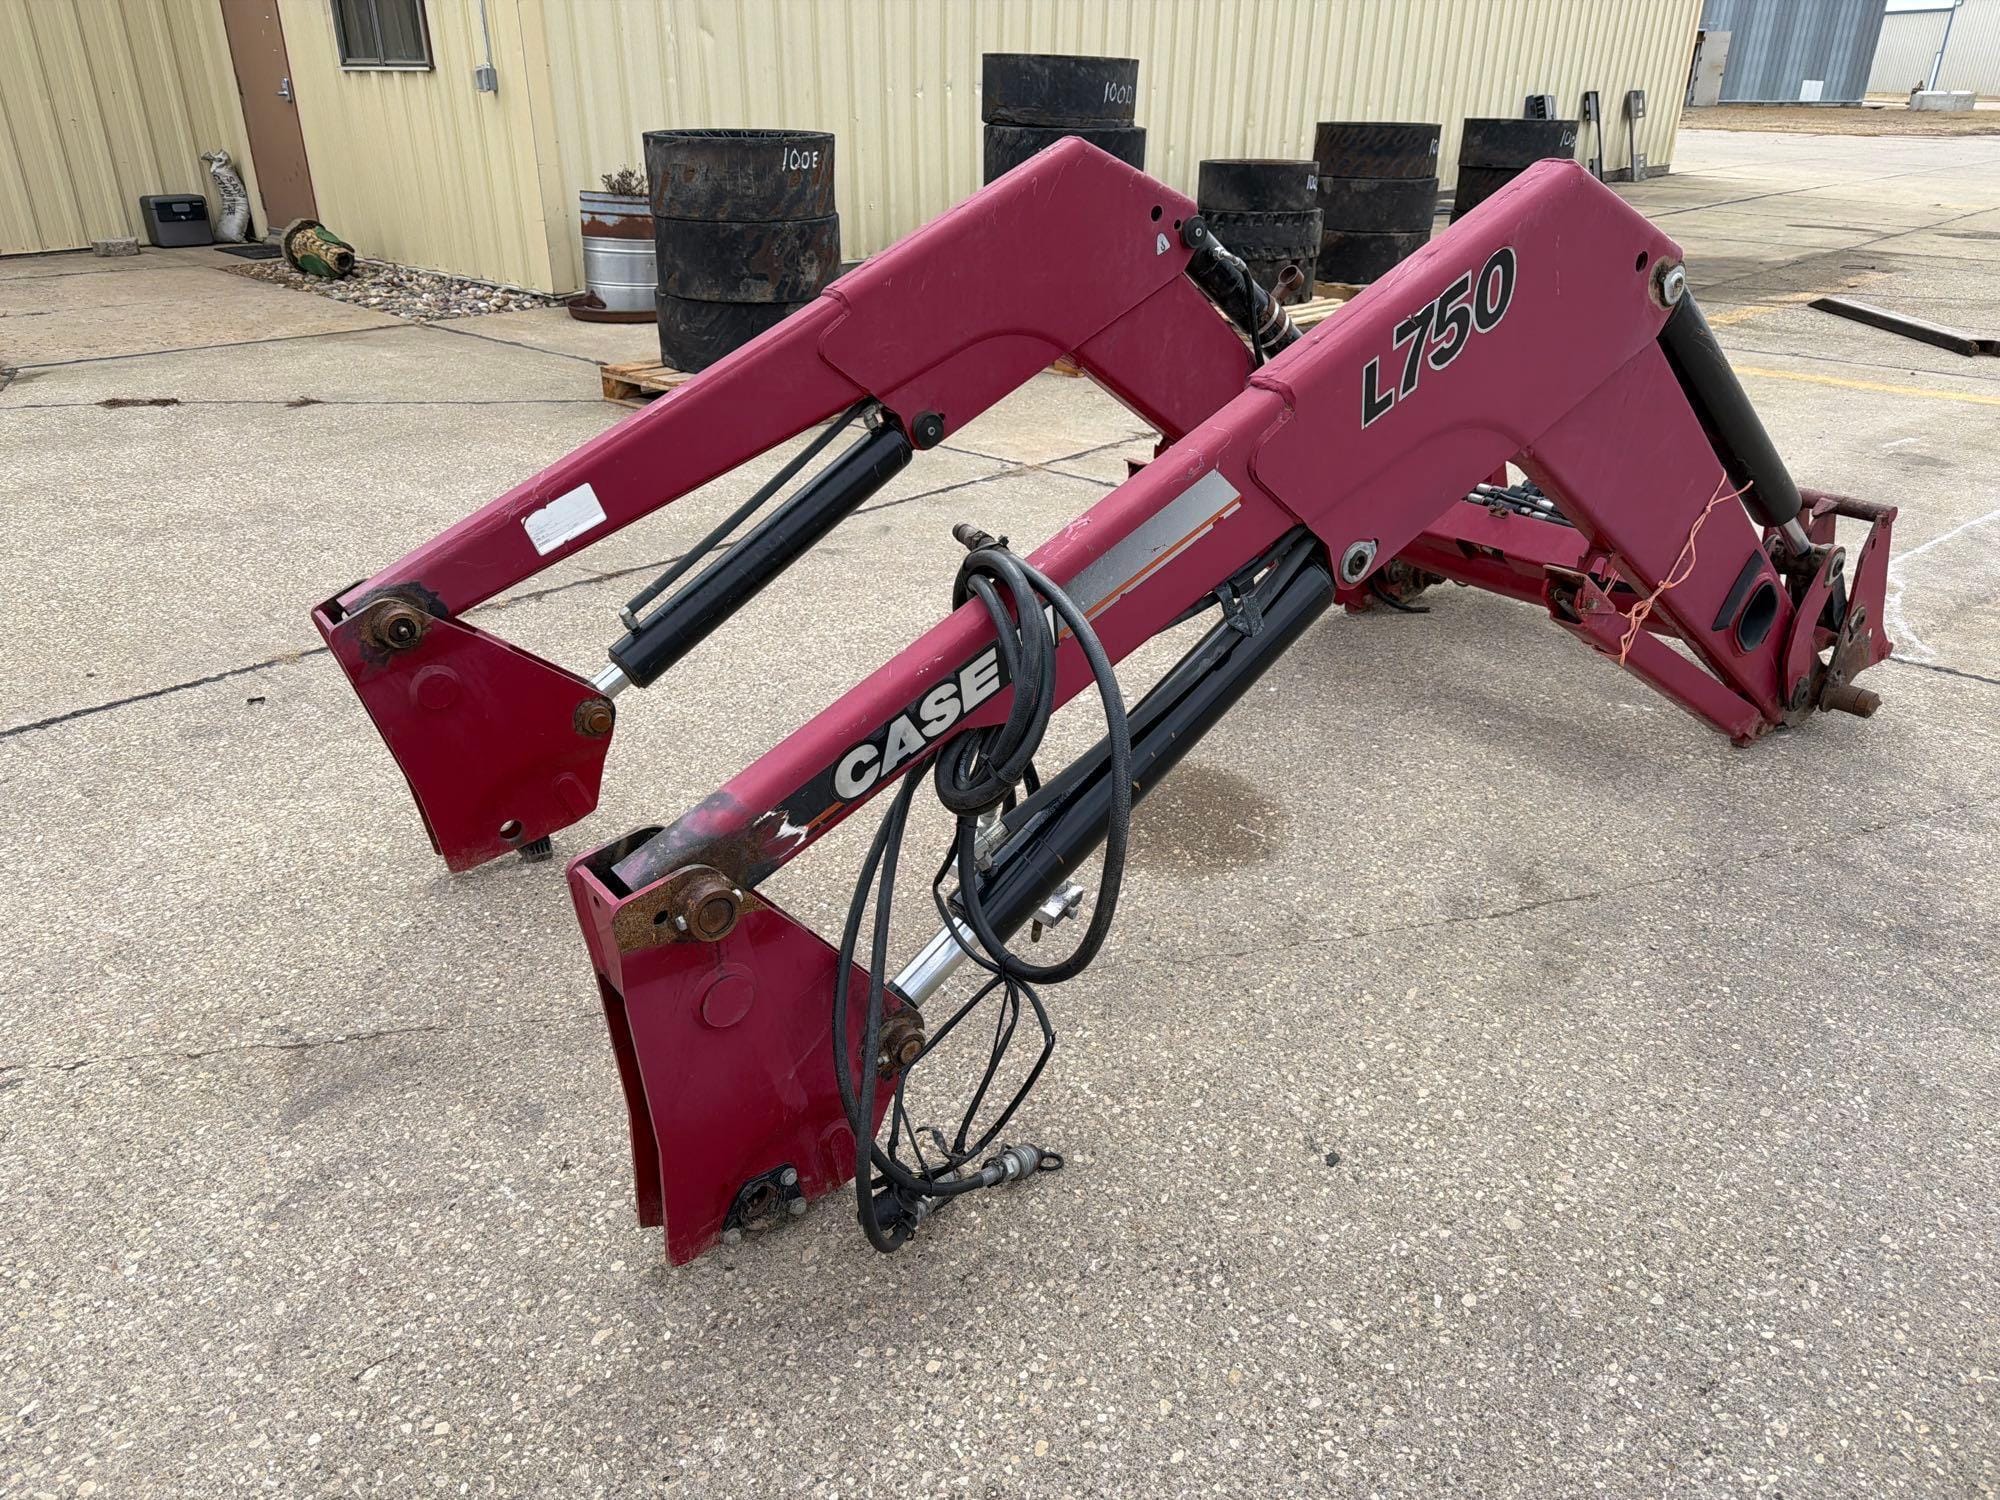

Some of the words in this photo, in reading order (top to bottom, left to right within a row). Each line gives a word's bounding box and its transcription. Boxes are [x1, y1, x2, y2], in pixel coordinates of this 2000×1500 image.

[781, 147, 819, 171] 100E
[1361, 246, 1517, 430] L750
[834, 646, 1000, 800] CASE
